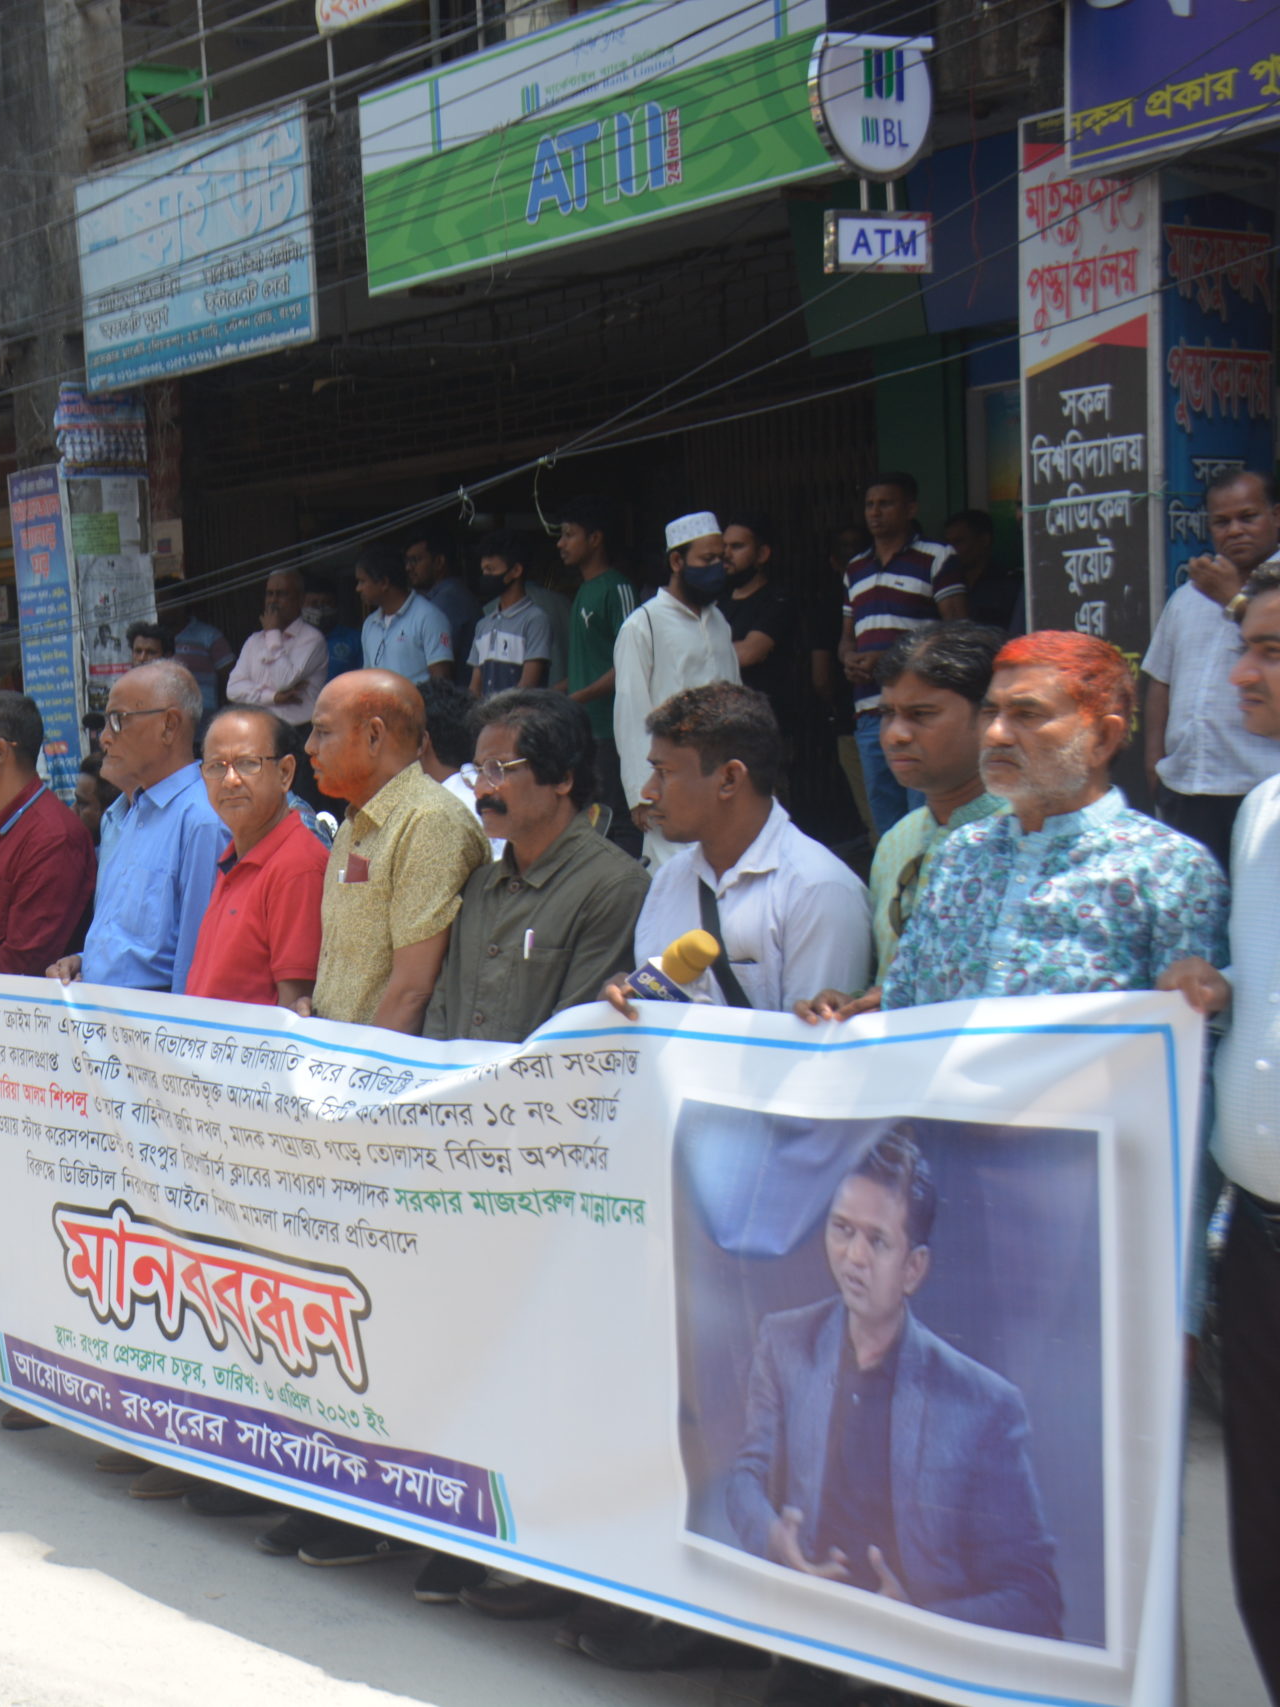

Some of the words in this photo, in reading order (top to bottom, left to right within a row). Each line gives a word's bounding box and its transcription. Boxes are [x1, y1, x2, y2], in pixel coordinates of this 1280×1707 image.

[1145, 68, 1239, 118] প্রকার
[851, 228, 917, 256] ATM
[1060, 383, 1112, 428] সকল
[1031, 429, 1144, 484] বিশ্ববিদ্যালয়
[1045, 483, 1132, 536] মেডিকেল
[1062, 534, 1115, 596] বুয়েট
[1075, 601, 1106, 636] এর
[155, 1025, 208, 1059] বিভাগের
[212, 1036, 238, 1065] জমি
[241, 1040, 305, 1073] জালিয়াতি
[309, 1058, 347, 1083] করে
[510, 1052, 553, 1079] করা
[560, 1047, 640, 1076] সংক্রান্ত
[22, 1083, 46, 1105] আলম
[49, 1082, 89, 1118] শিপলু
[229, 1125, 265, 1147] মাদক
[268, 1132, 320, 1161] সাম্রাজ্য
[324, 1141, 361, 1166] গড়ে
[367, 1143, 443, 1173] তোলাসহ
[444, 1139, 512, 1176] বিভিন্ন
[518, 1135, 609, 1171] অপকর্মের
[226, 1081, 272, 1113] আসামী
[274, 1091, 314, 1123] রংপুর
[484, 1102, 516, 1127] ১৫
[524, 1101, 562, 1125] নং
[568, 1088, 621, 1122] ওয়ার্ড
[59, 1157, 116, 1192] ডিজিটাল
[164, 1179, 209, 1215] আইনে
[241, 1203, 278, 1232] মামলা
[282, 1207, 340, 1242] দাখিলের
[345, 1217, 420, 1256] প্রতিবাদে
[139, 1142, 178, 1172] রংপুর
[228, 1162, 271, 1187] ক্লাবের
[275, 1169, 326, 1198] সাধারণ
[331, 1176, 391, 1209] সম্পাদক
[394, 1187, 462, 1216] সরকার
[468, 1188, 576, 1217] মাজহারুল
[580, 1191, 646, 1227] মান্নানের
[58, 1212, 363, 1380] মানববন্ধন
[53, 1324, 77, 1350] স্থান:
[80, 1332, 108, 1363] রংপুর
[113, 1343, 167, 1375] প্রেসক্লাব
[172, 1358, 207, 1388] চত্বর,
[212, 1364, 260, 1397] তারিখ:
[277, 1382, 313, 1414] এপ্রিল
[316, 1398, 360, 1430] ২০২৩
[364, 1402, 391, 1436] ইং
[13, 1350, 111, 1411] আয়োজনে:
[120, 1387, 225, 1446] রংপুরের
[236, 1417, 367, 1486] সাংবাদিক
[381, 1454, 468, 1513] সমাজ
